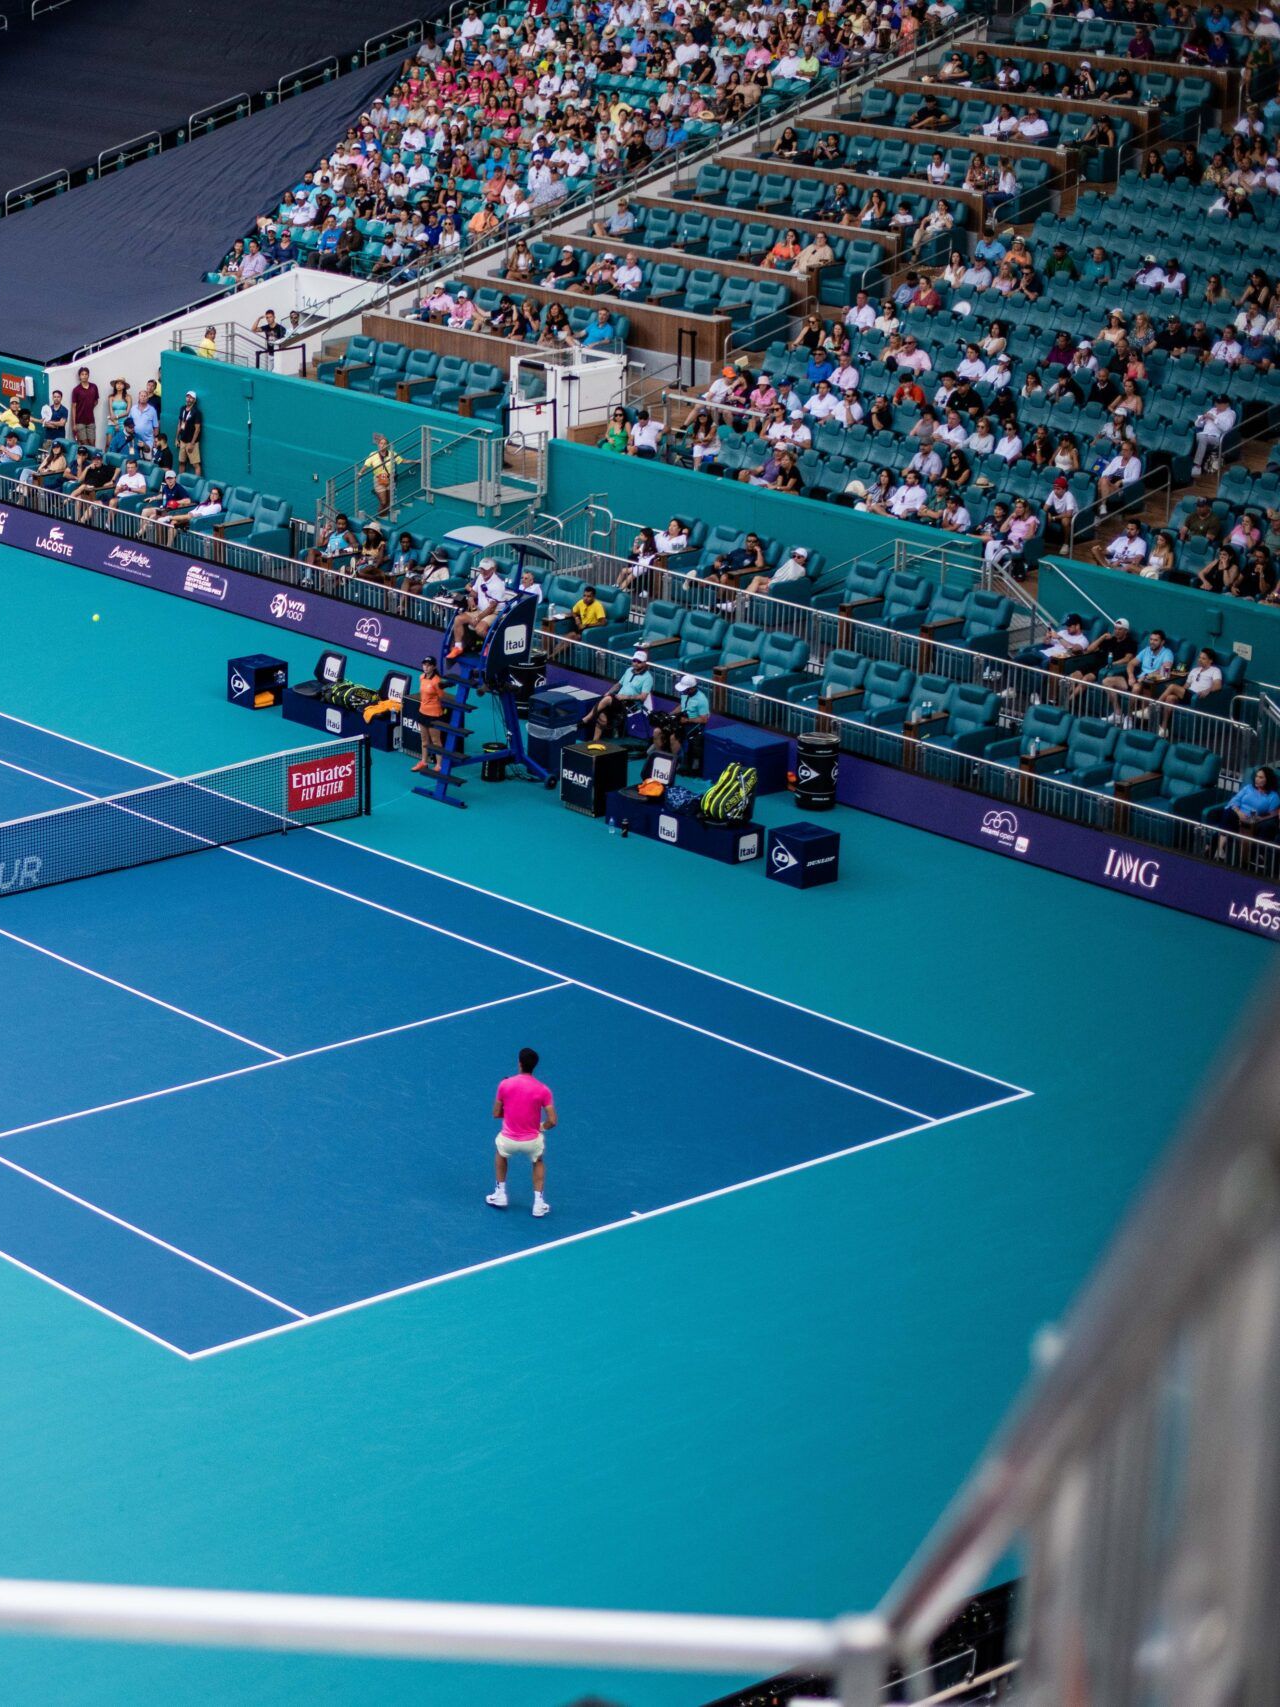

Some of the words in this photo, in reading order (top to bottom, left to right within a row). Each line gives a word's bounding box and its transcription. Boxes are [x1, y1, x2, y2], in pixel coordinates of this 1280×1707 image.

[35, 536, 74, 557] LACOSTE
[286, 610, 303, 622] 1000
[505, 637, 525, 651] Itaú
[291, 763, 353, 789] Emirates
[562, 768, 591, 786] READY
[652, 768, 669, 781] Itaú
[301, 786, 316, 802] FLY
[316, 780, 344, 798] BETTER
[659, 825, 676, 839] Itaú
[739, 843, 756, 858] Itaú
[806, 855, 836, 868] DUNLOP
[1103, 848, 1160, 889] IMG
[1228, 902, 1280, 931] LACOS
